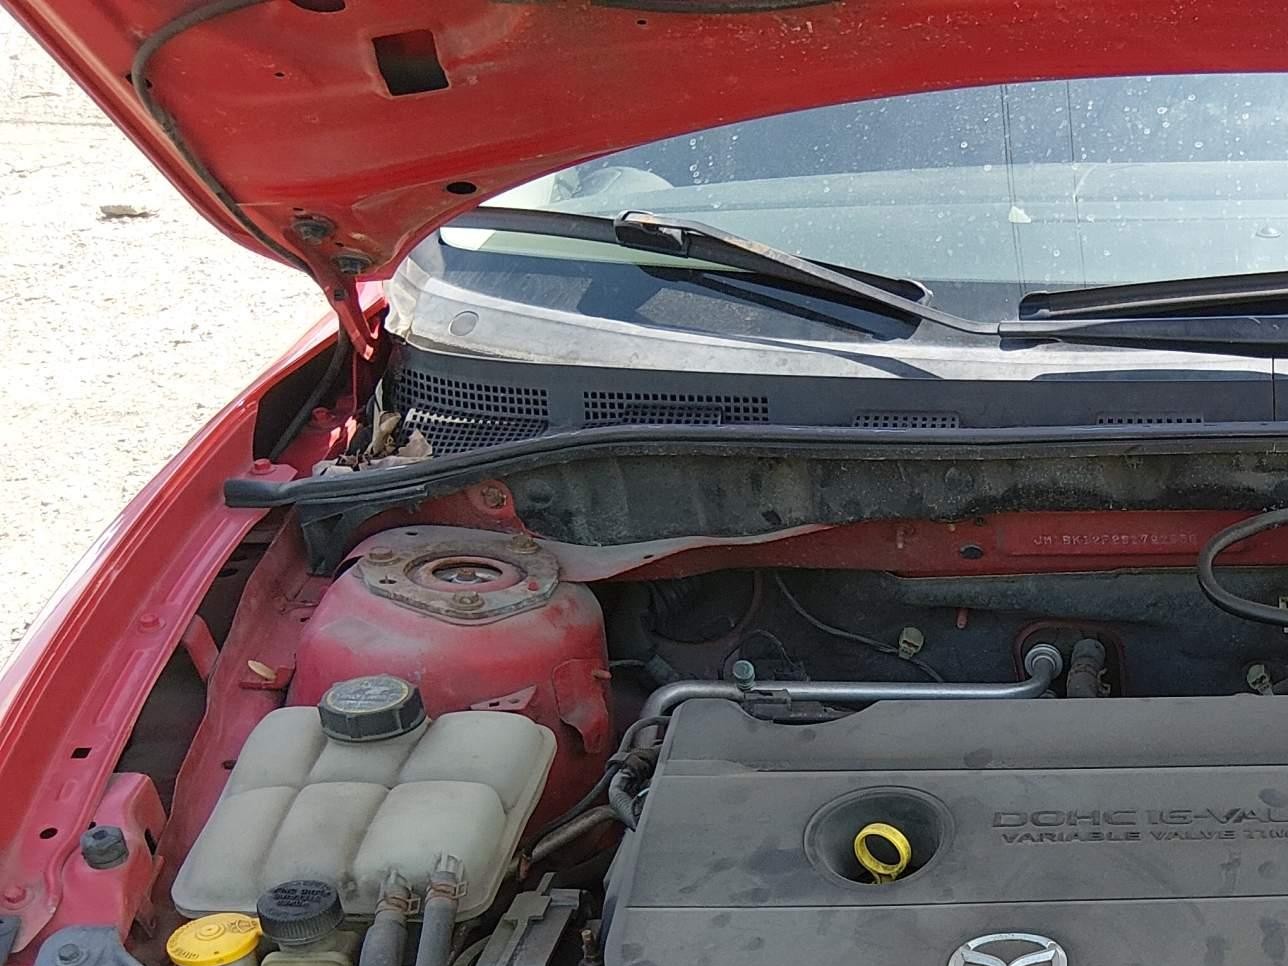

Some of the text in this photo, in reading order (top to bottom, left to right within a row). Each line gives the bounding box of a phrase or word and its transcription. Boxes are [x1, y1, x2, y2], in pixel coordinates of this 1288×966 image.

[991, 808, 1138, 829] DOHC
[1002, 830, 1142, 844] VARIABLE
[1150, 829, 1236, 842] VALVE
